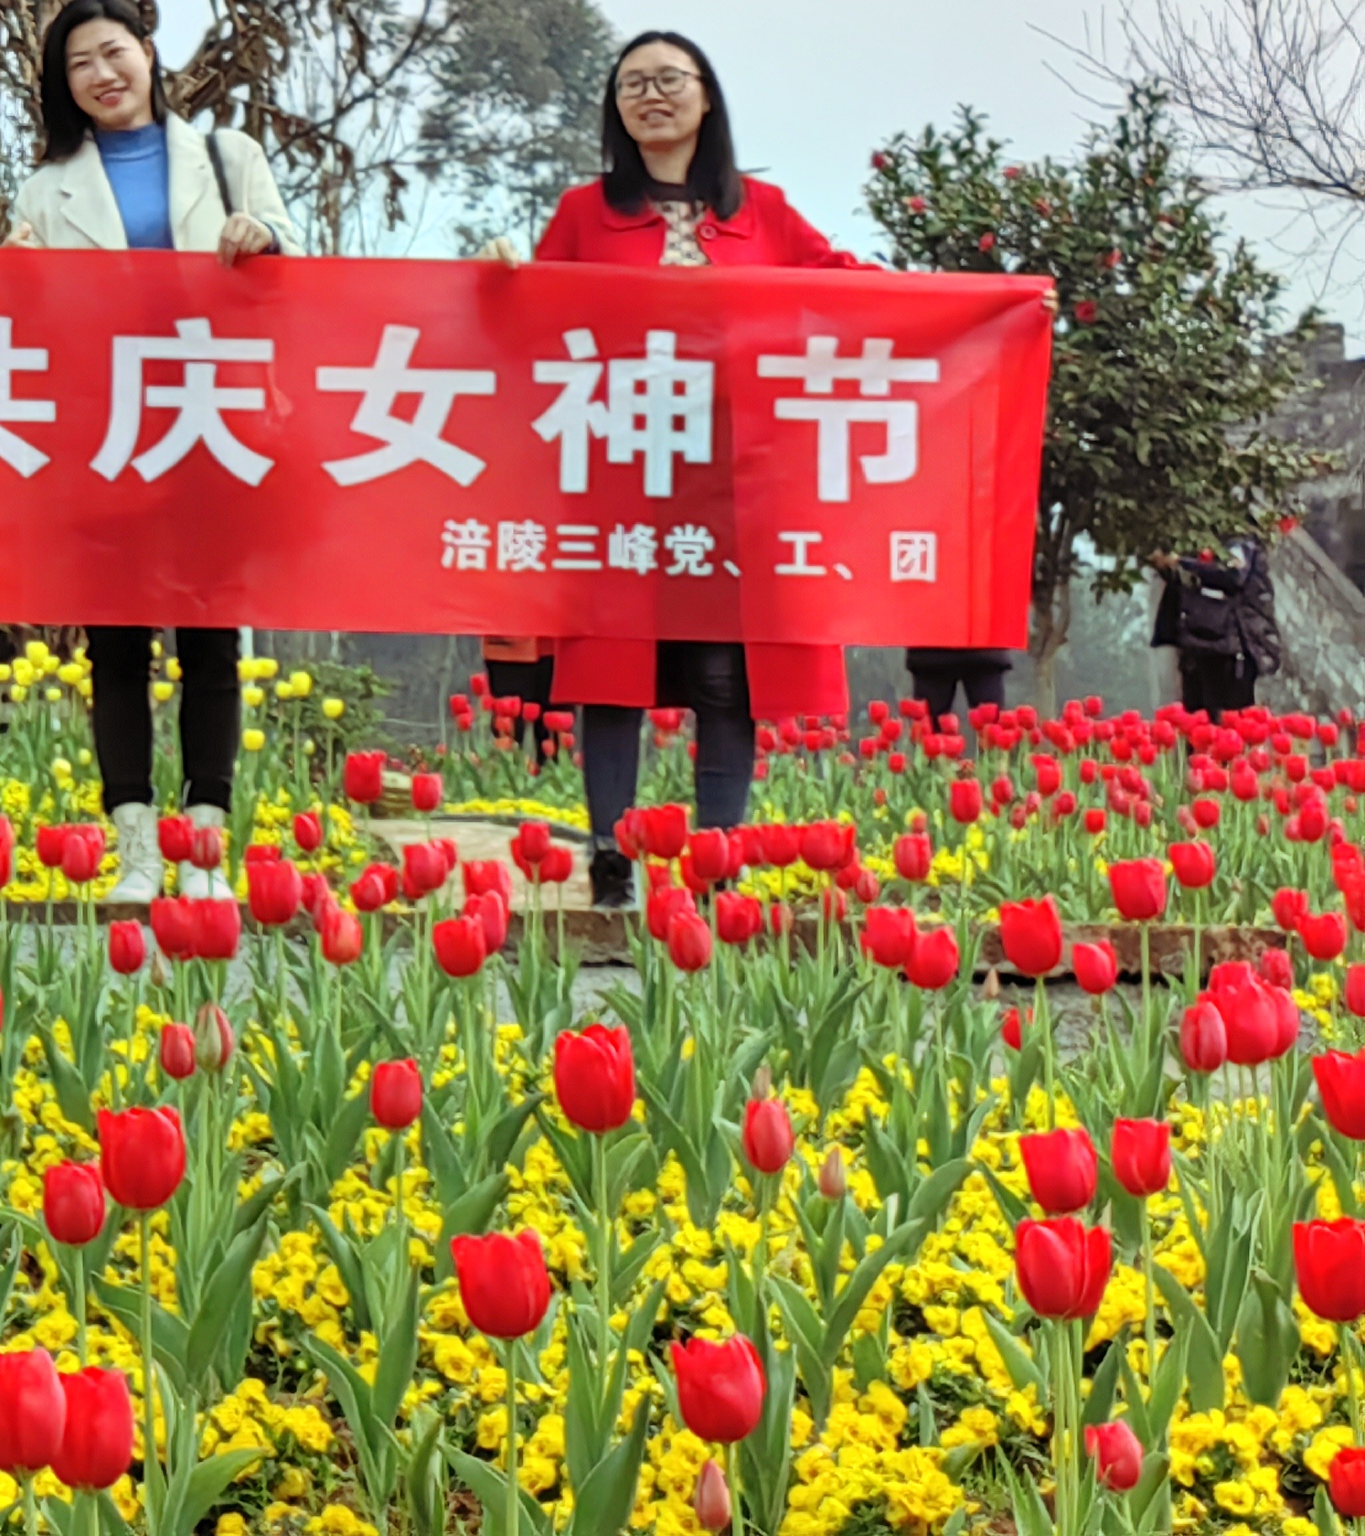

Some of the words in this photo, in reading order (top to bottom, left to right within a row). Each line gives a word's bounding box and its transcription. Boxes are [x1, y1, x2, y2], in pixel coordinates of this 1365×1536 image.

[440, 517, 938, 583] 涪陵三峰党、工、团
